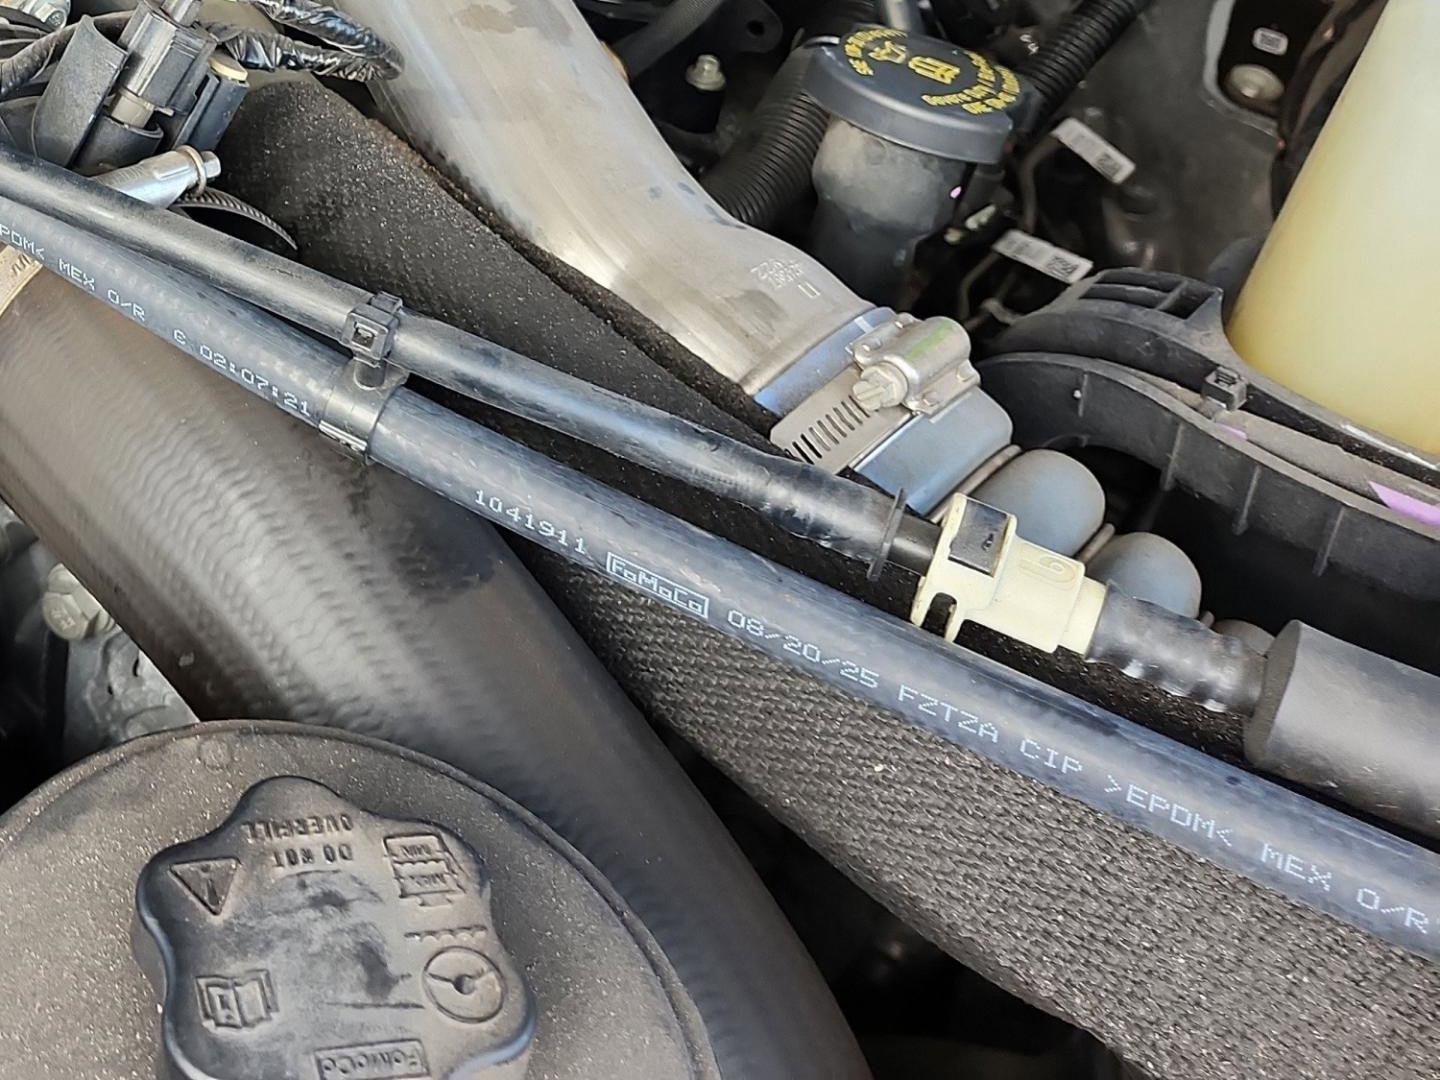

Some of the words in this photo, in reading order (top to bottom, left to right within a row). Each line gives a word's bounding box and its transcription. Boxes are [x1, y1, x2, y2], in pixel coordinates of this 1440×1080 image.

[58, 258, 95, 291] MEX
[199, 346, 311, 417] 02:07:21
[474, 489, 587, 555] 1041911
[608, 554, 708, 617] FoMoCo
[727, 609, 880, 689] 08/20/25
[1019, 739, 1083, 776] CIP
[1104, 774, 1235, 848] >EPDM<
[1261, 841, 1333, 891] MEX
[244, 813, 355, 842] OVERFILL
[272, 845, 313, 868] NOT
[325, 843, 354, 864] DO
